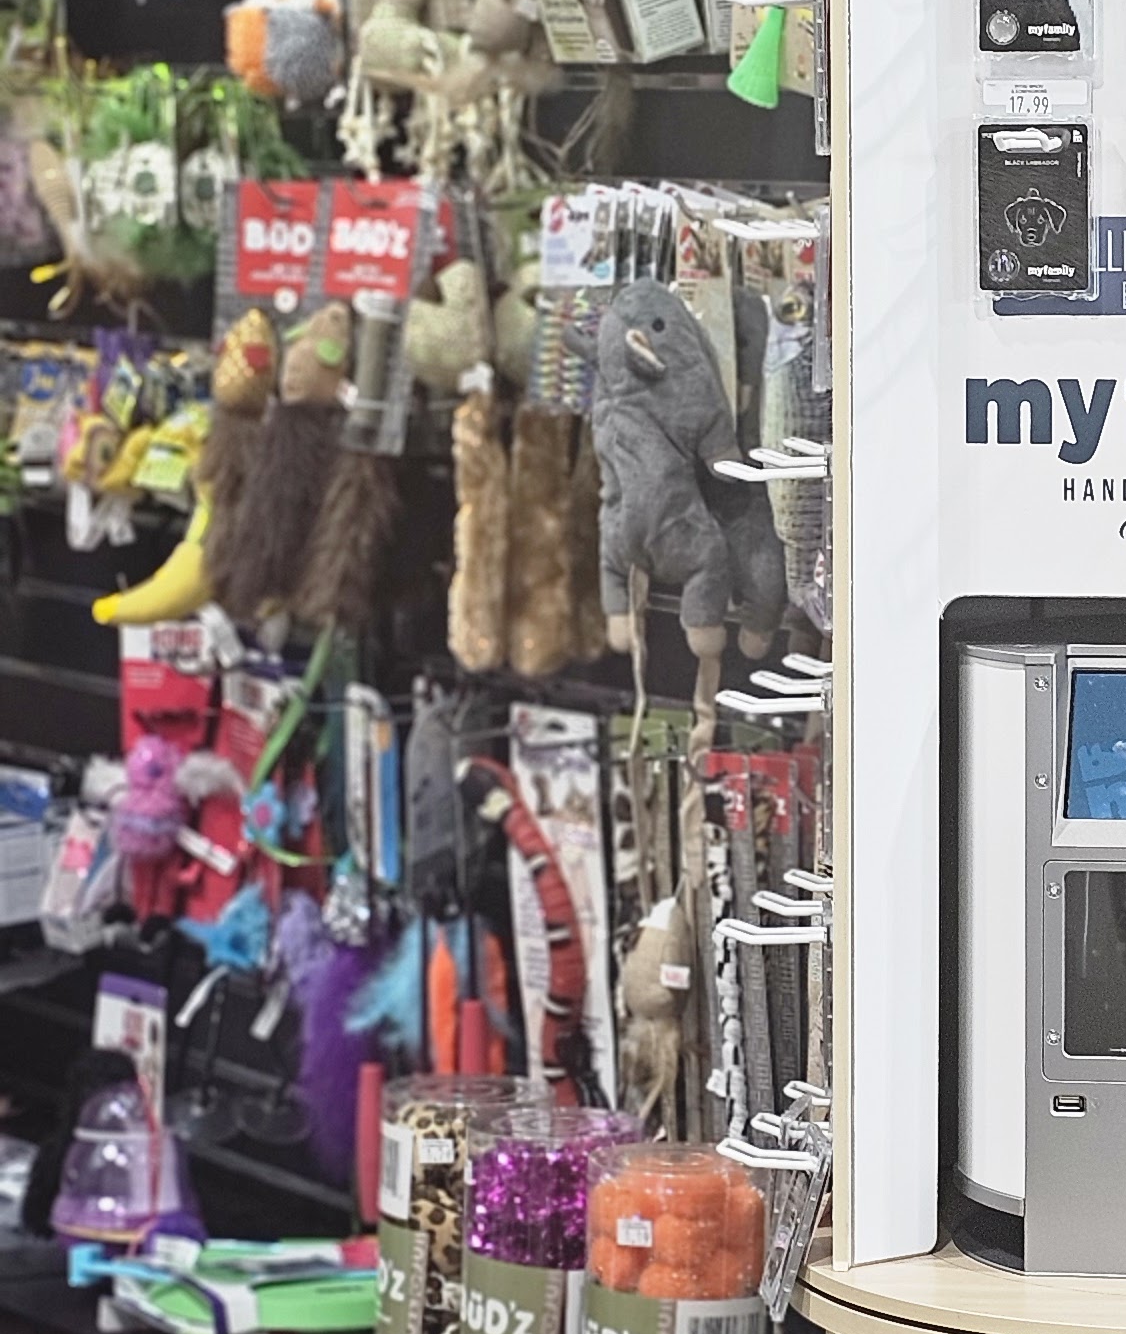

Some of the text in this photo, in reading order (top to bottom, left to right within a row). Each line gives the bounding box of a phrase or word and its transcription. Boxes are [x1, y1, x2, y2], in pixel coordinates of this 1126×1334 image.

[1028, 24, 1075, 36] myfamily
[1010, 96, 1049, 114] 17.99
[1027, 264, 1075, 277] myfamily
